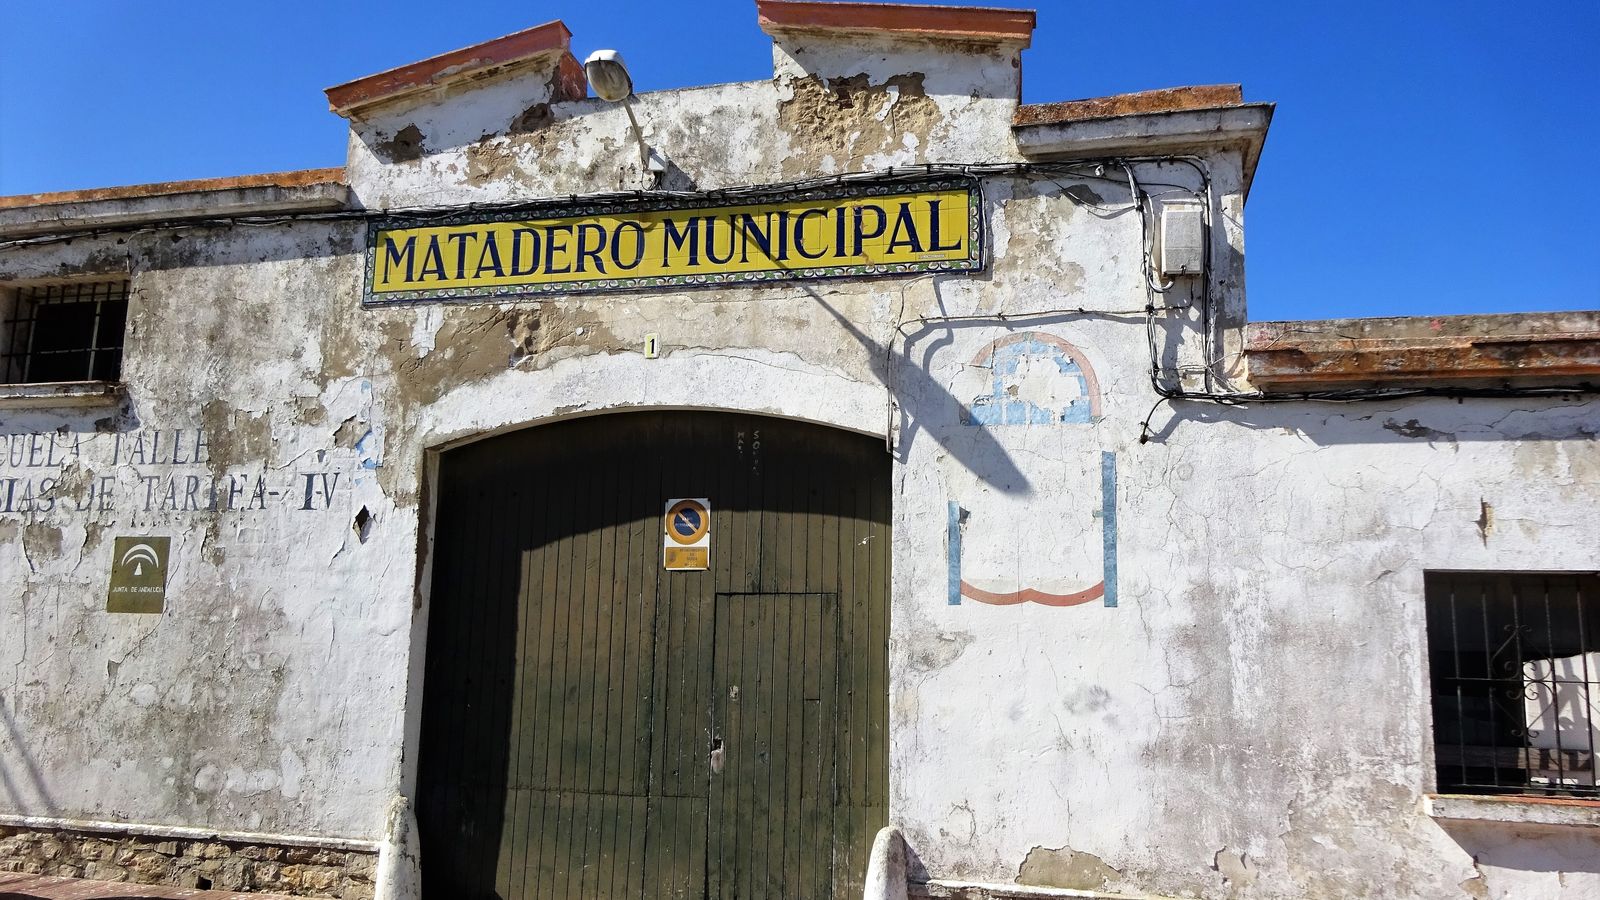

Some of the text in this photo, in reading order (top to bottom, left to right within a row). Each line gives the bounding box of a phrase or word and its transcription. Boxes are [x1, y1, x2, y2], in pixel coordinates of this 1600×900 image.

[381, 200, 962, 284] MATADERO MUNICIPAL
[649, 338, 655, 354] 1
